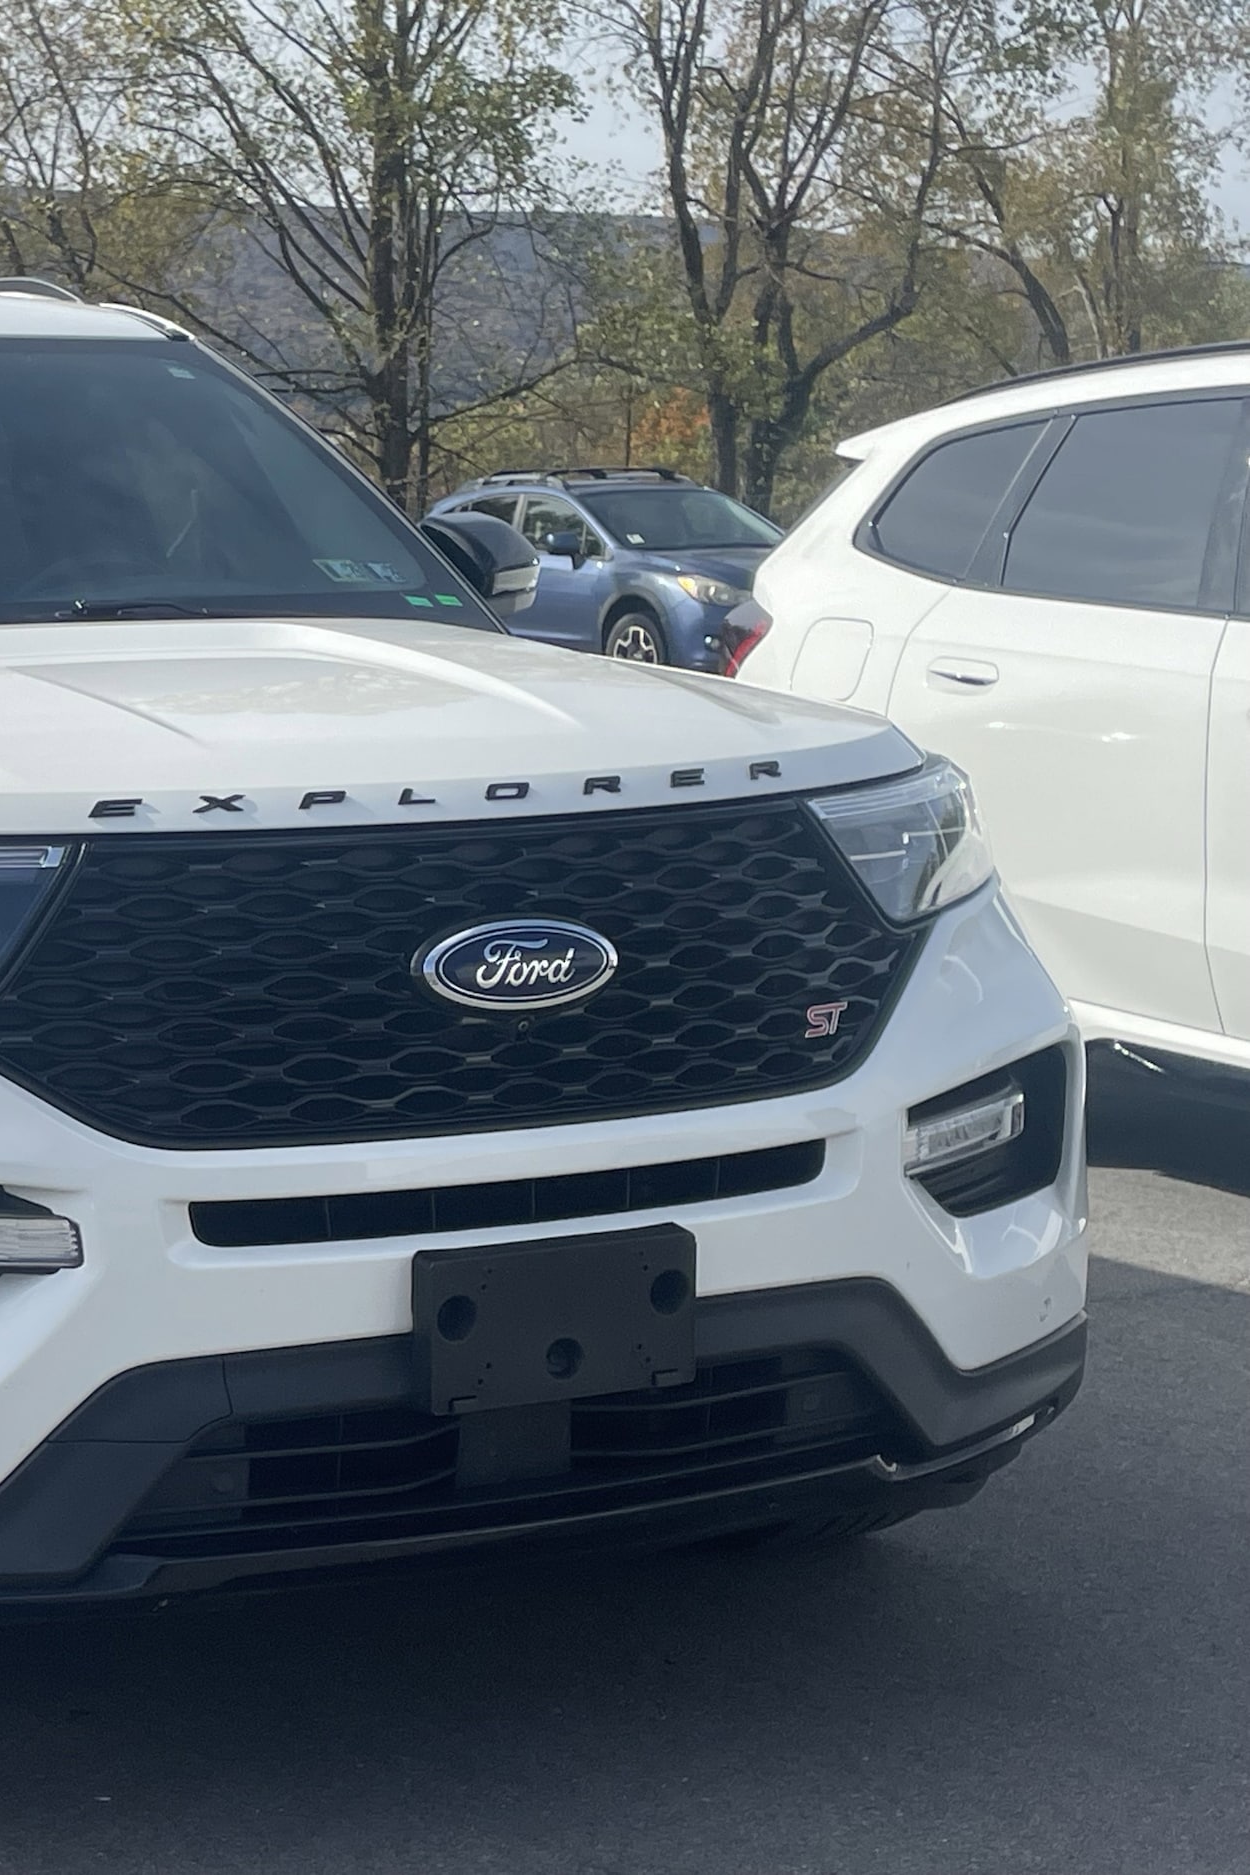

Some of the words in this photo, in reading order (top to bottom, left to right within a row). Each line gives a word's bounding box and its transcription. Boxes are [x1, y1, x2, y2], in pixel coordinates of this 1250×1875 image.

[88, 760, 782, 819] EXPLORER
[476, 938, 576, 989] Ford
[805, 1002, 847, 1039] ST
